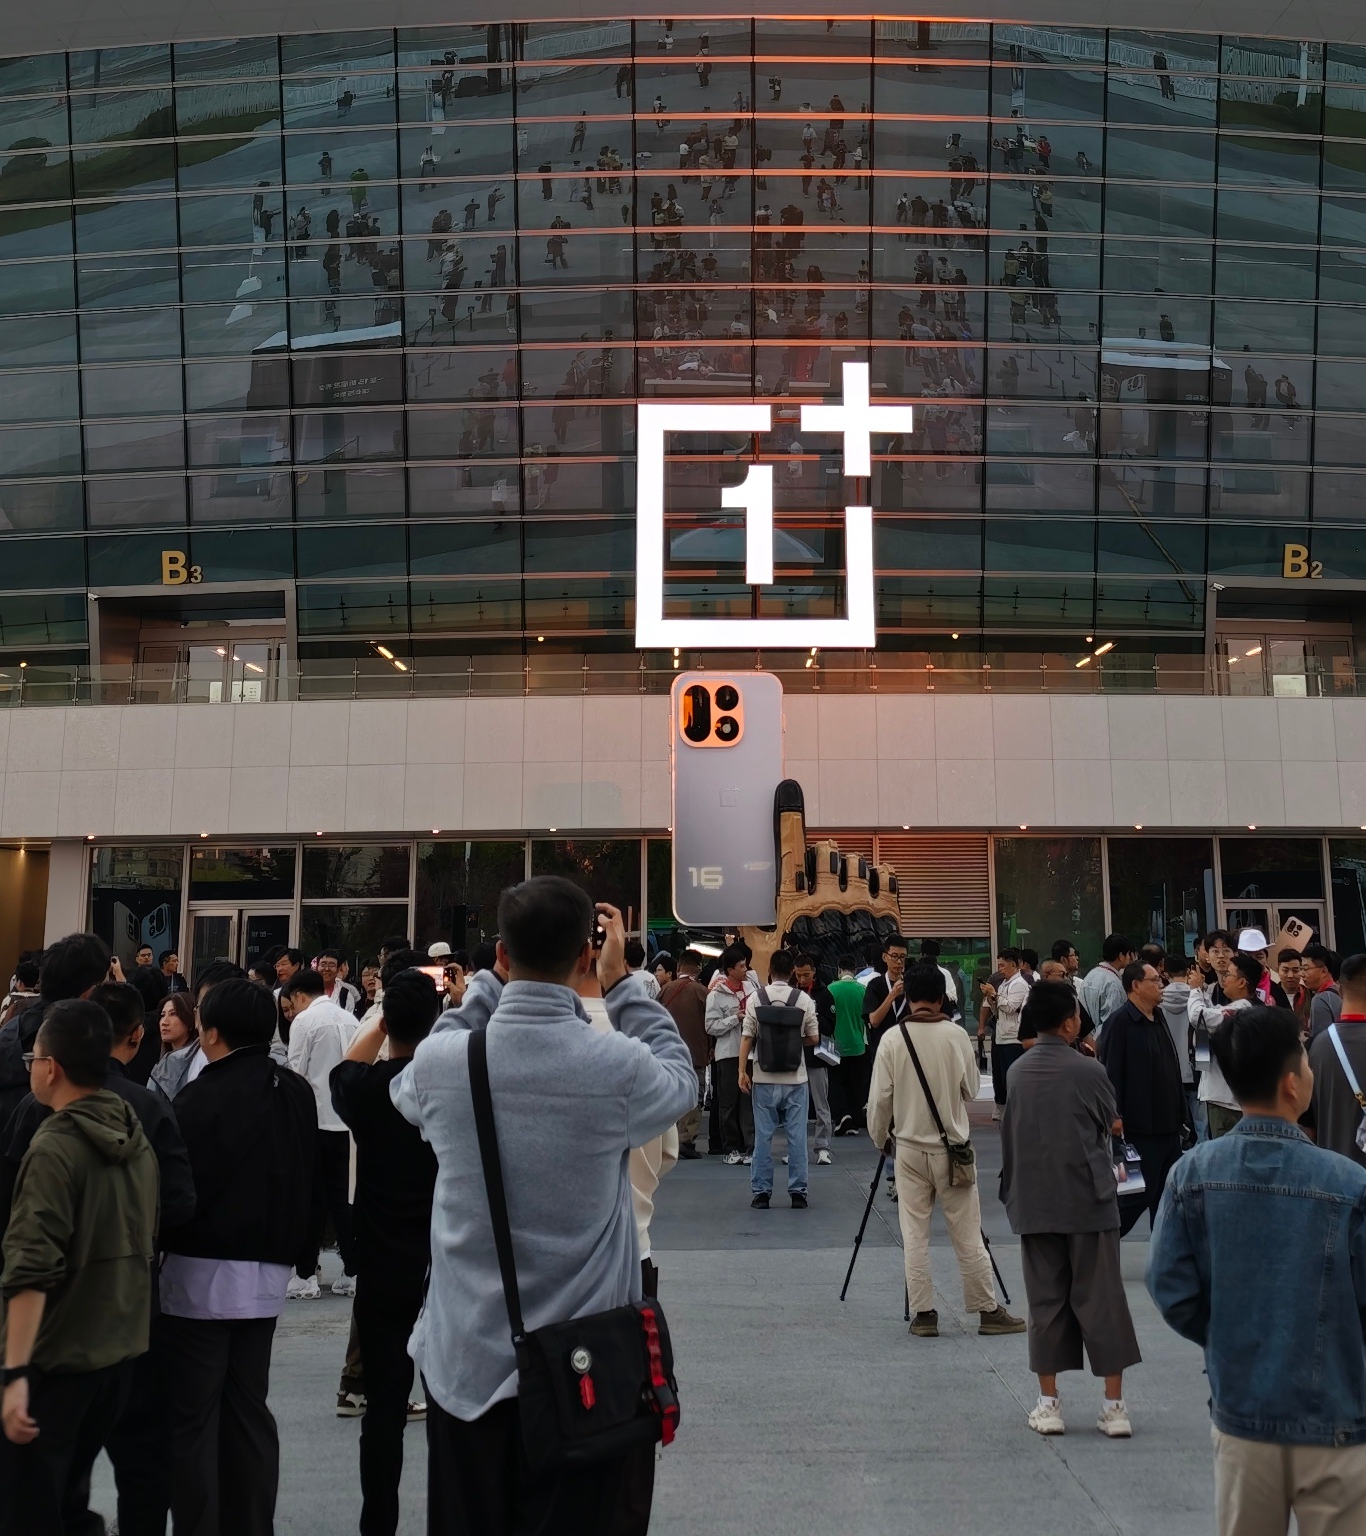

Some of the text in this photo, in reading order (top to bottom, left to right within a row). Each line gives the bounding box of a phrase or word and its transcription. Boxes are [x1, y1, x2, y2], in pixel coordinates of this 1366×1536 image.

[161, 550, 203, 585] B3
[1283, 543, 1323, 579] B2
[688, 866, 723, 887] 16
